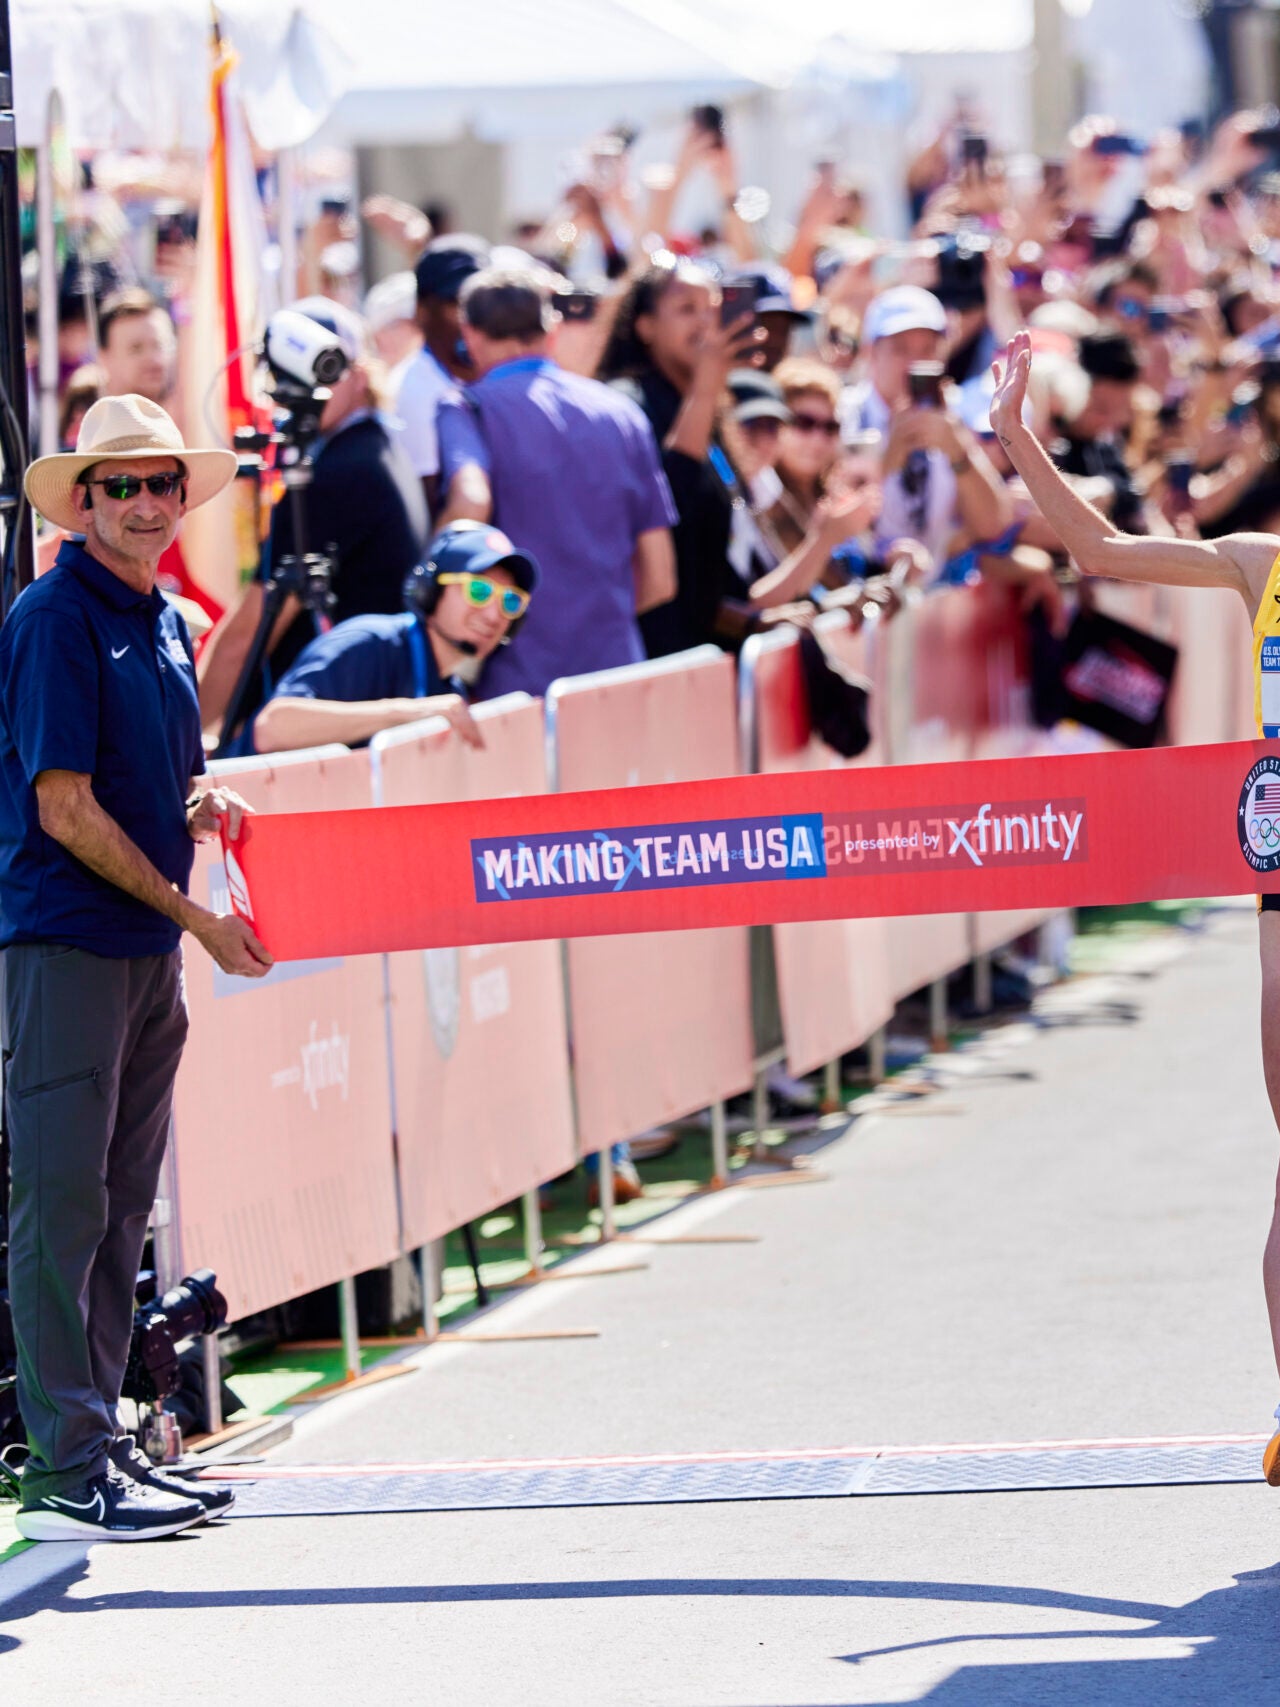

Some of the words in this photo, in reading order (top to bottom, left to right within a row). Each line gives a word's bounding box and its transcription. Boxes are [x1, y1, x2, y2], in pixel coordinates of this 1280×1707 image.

[1263, 646, 1272, 656] U.S.
[1263, 657, 1277, 667] TEAM
[1244, 760, 1267, 791] UNITED
[845, 831, 918, 855] presented
[922, 832, 940, 849] by
[947, 803, 1083, 866] xfinity
[483, 840, 624, 890] MAKING
[633, 832, 730, 878] TEAM
[741, 826, 815, 869] USA
[1242, 841, 1268, 869] OLYMPIC
